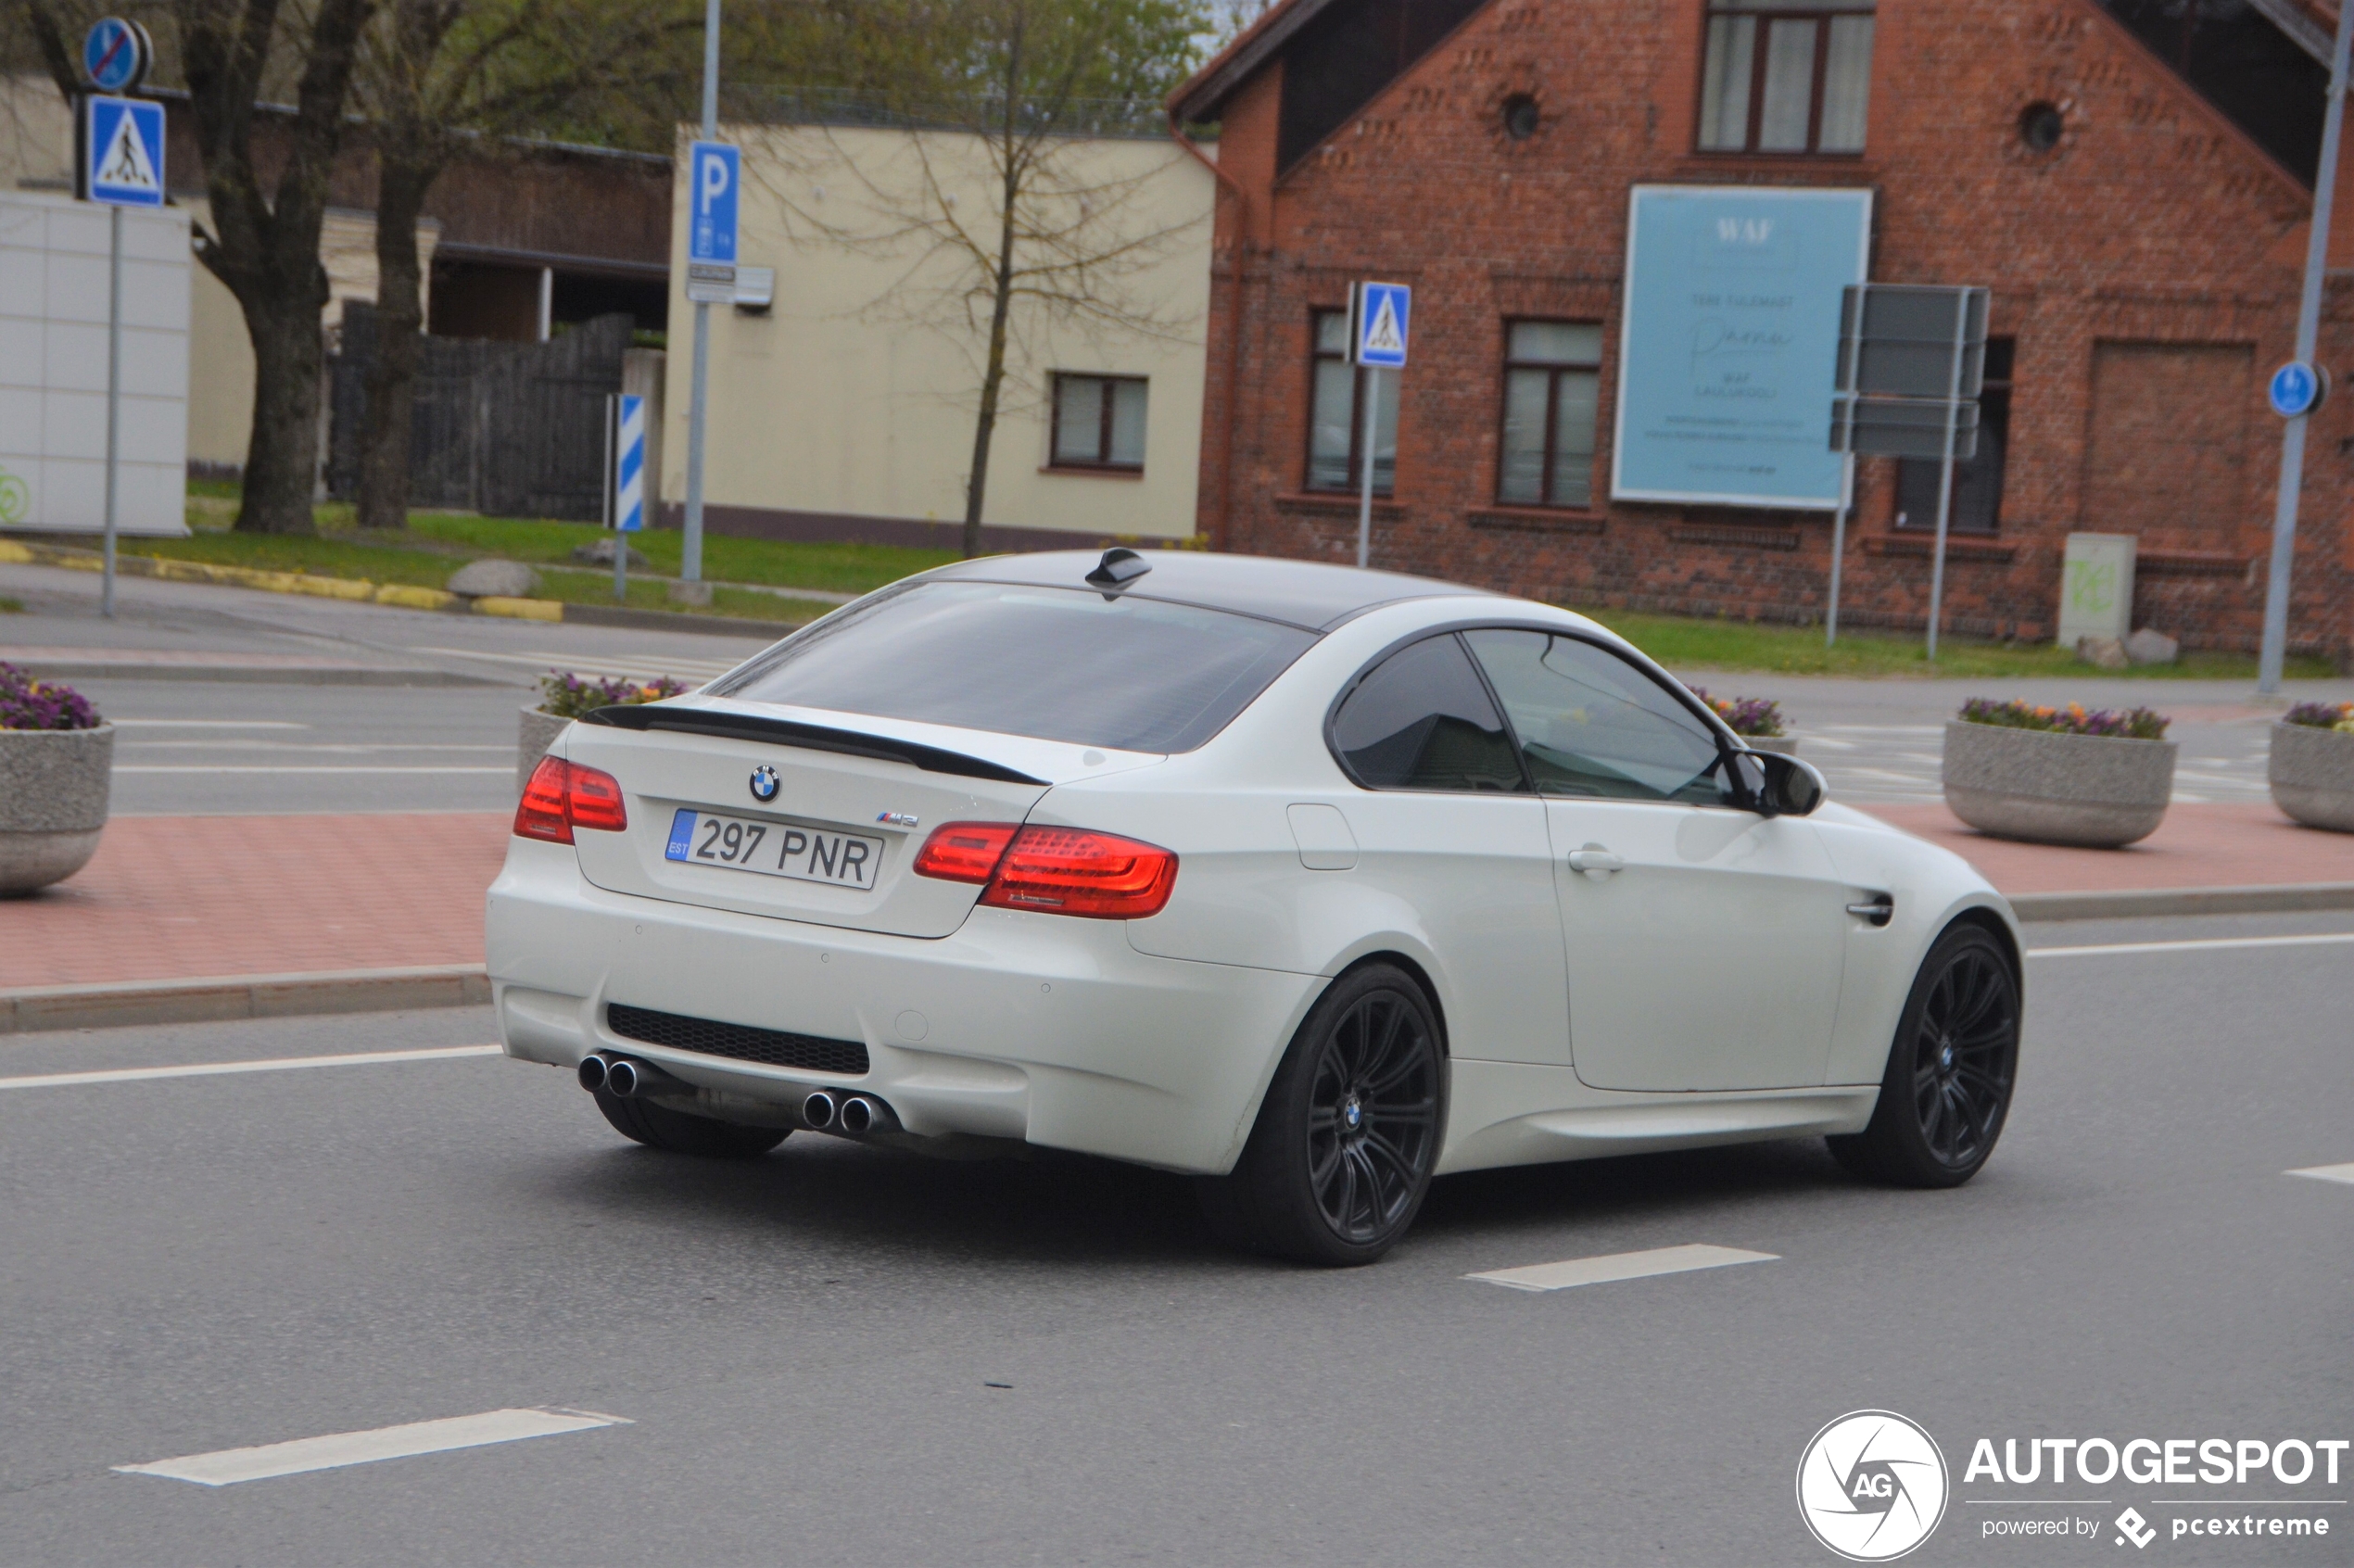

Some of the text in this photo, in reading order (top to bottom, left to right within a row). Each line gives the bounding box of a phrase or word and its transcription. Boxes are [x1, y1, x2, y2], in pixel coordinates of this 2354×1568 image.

[702, 154, 729, 214] P
[887, 812, 918, 828] M3
[668, 841, 689, 855] EST
[696, 819, 869, 881] 297 PNR
